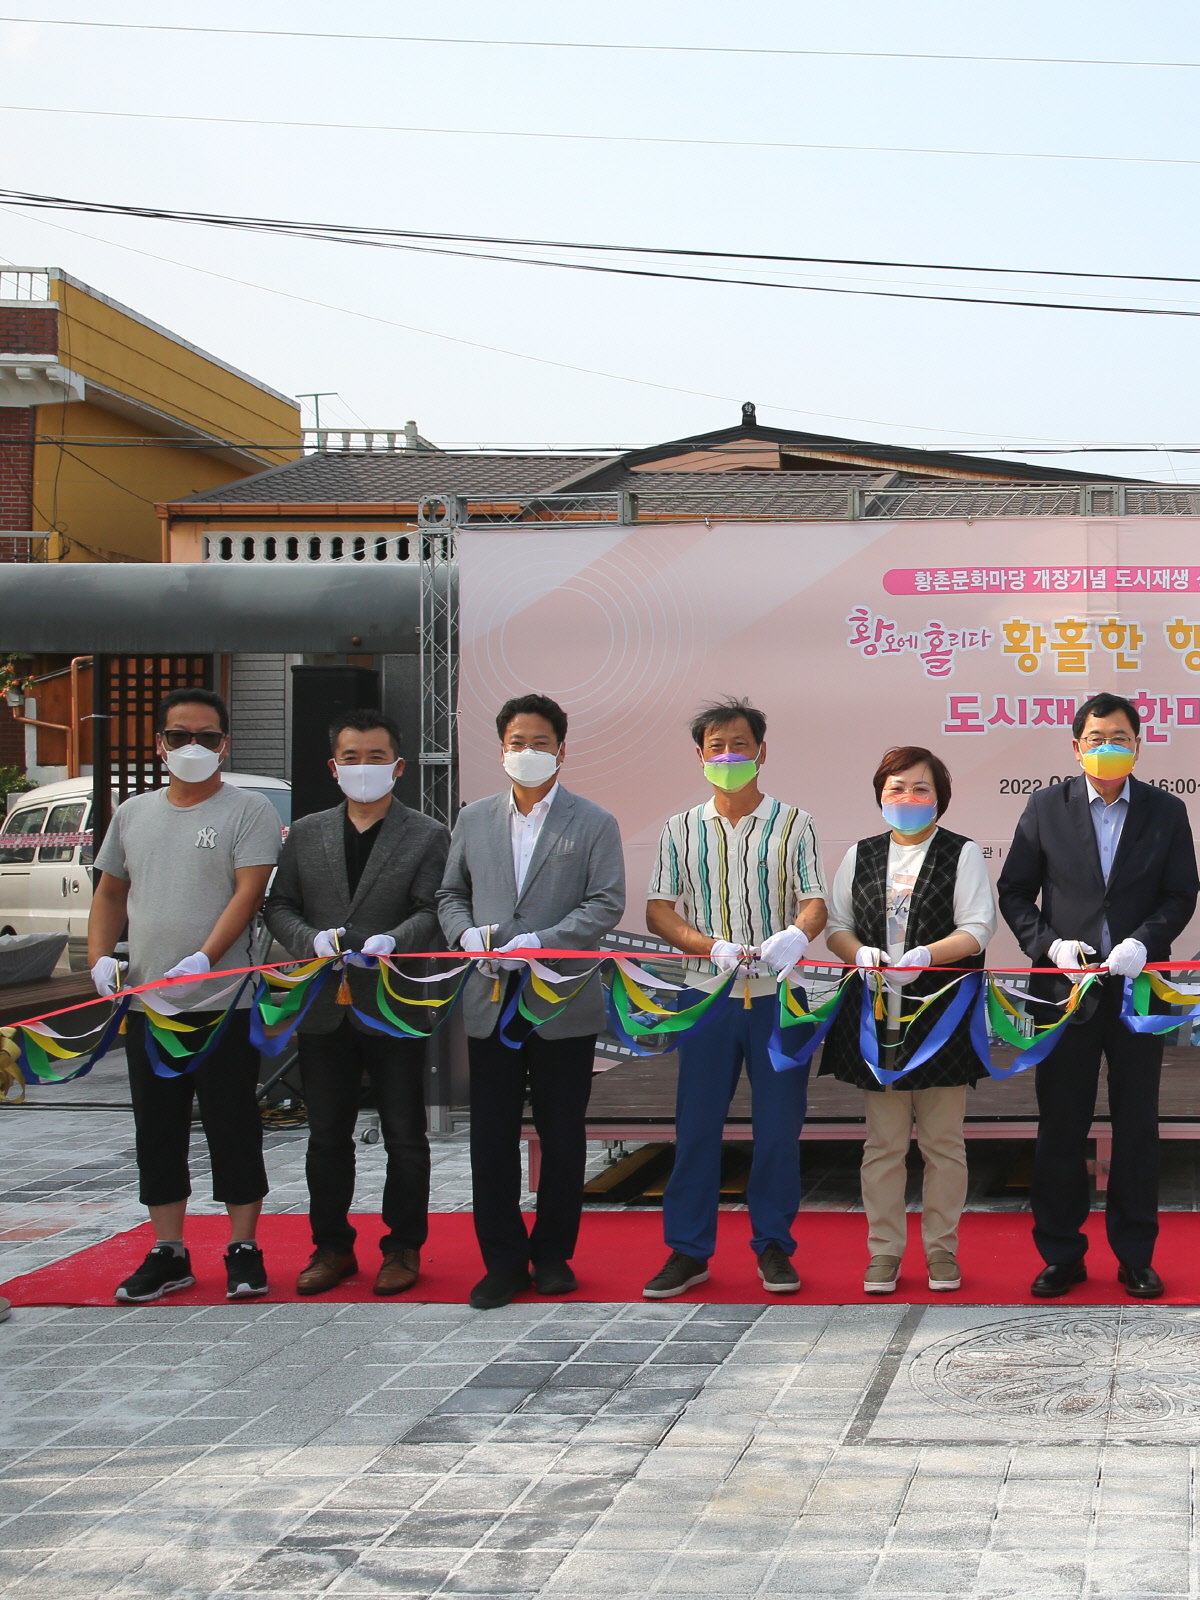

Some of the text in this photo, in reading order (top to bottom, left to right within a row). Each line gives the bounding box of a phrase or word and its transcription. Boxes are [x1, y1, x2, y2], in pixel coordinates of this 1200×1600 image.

[914, 569, 1026, 592] 황촌문화마당
[1032, 569, 1106, 590] 개장기념
[1114, 569, 1189, 589] 도시재생
[1001, 618, 1144, 673] 황홀한
[944, 694, 1098, 734] 도시재
